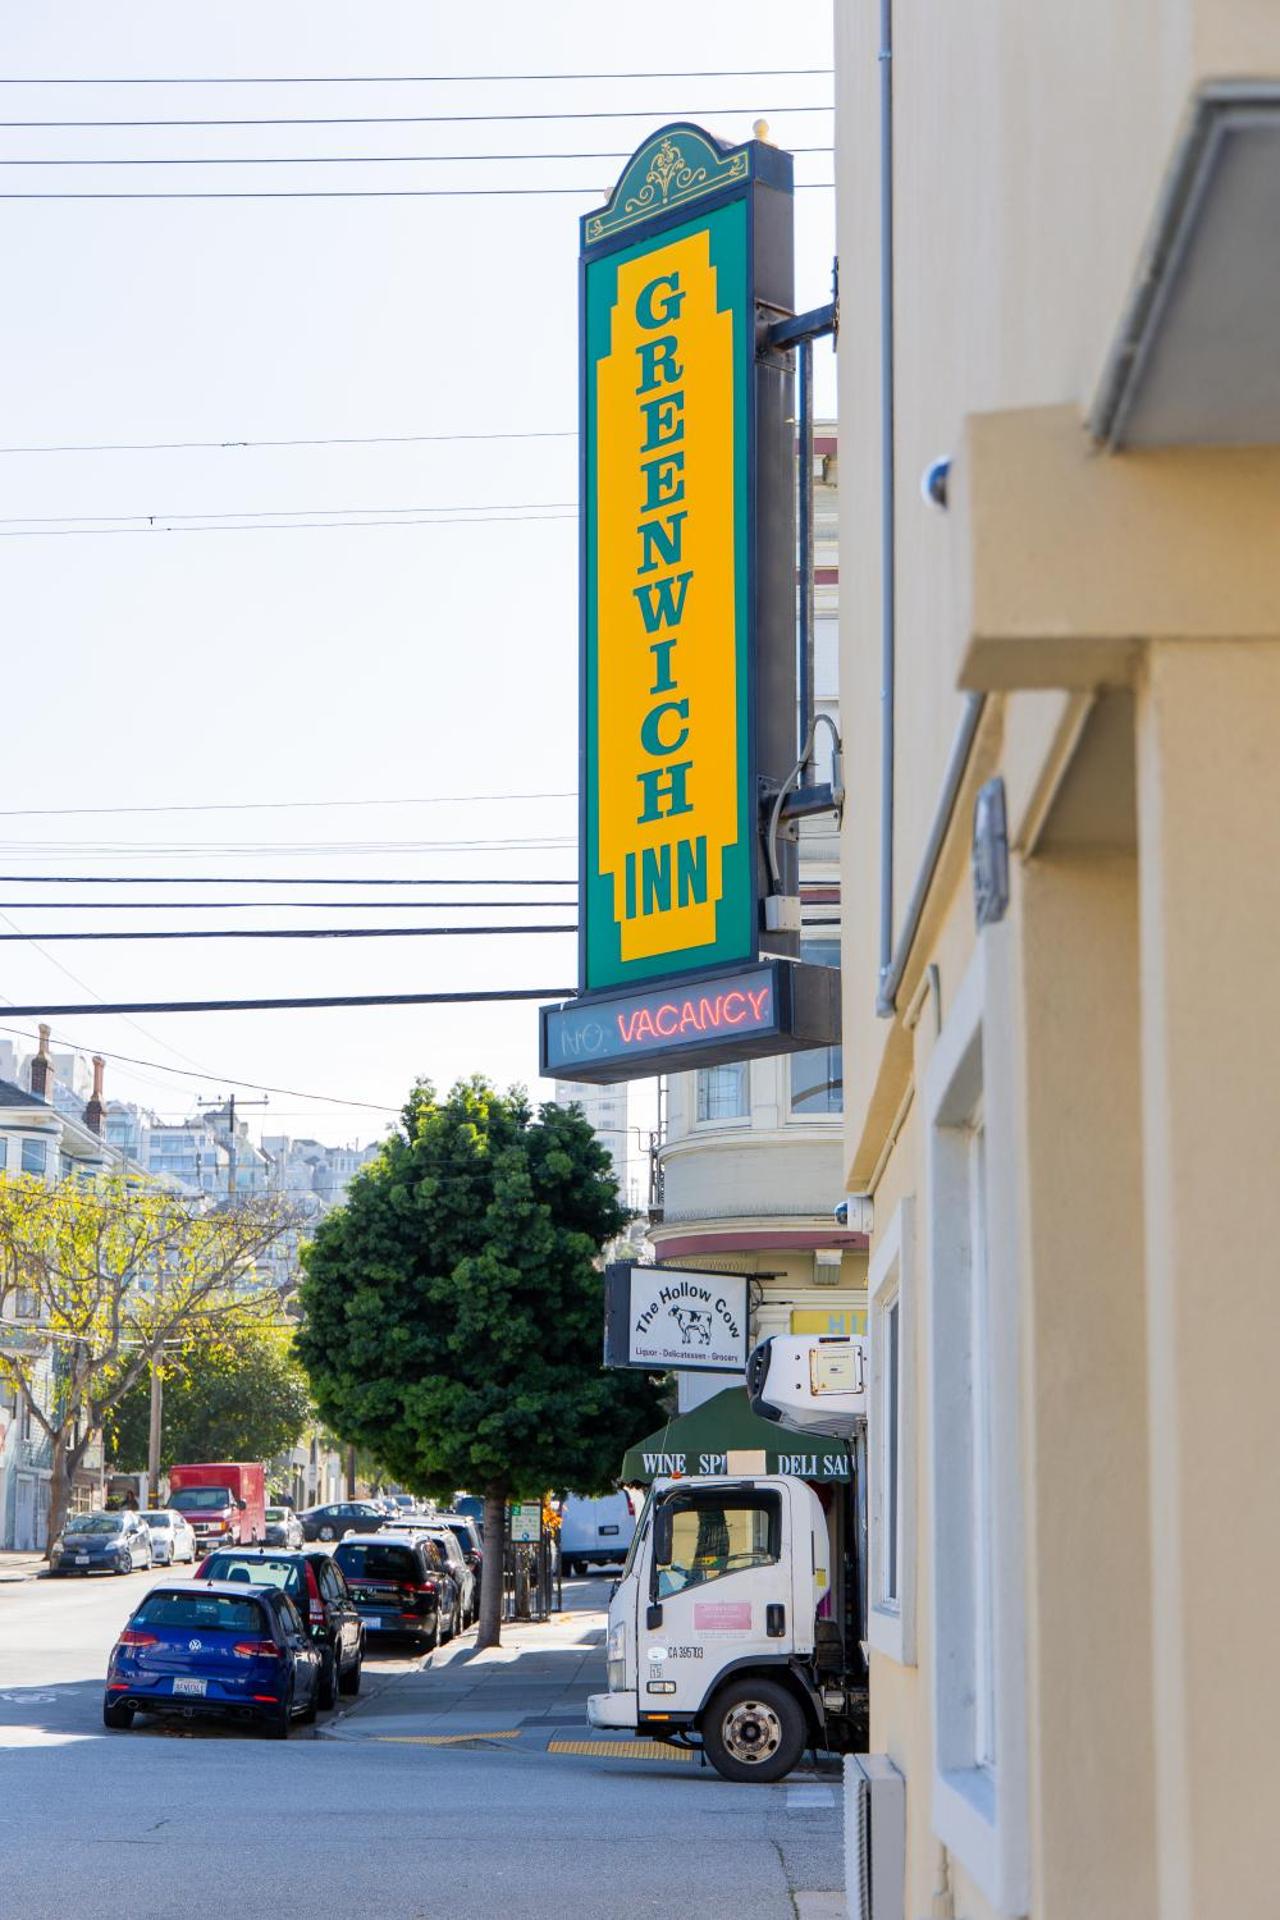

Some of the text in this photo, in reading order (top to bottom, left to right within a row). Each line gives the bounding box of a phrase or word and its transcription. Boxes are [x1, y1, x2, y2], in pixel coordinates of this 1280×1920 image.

[633, 270, 694, 824] GREENWICH
[625, 835, 708, 920] INN
[616, 987, 769, 1044] VACANCY
[635, 1281, 740, 1338] The Hollow Cow
[635, 1346, 738, 1362] Liquor Delicatessen Grocery
[642, 1453, 687, 1474] WINE
[778, 1454, 817, 1476] DELI
